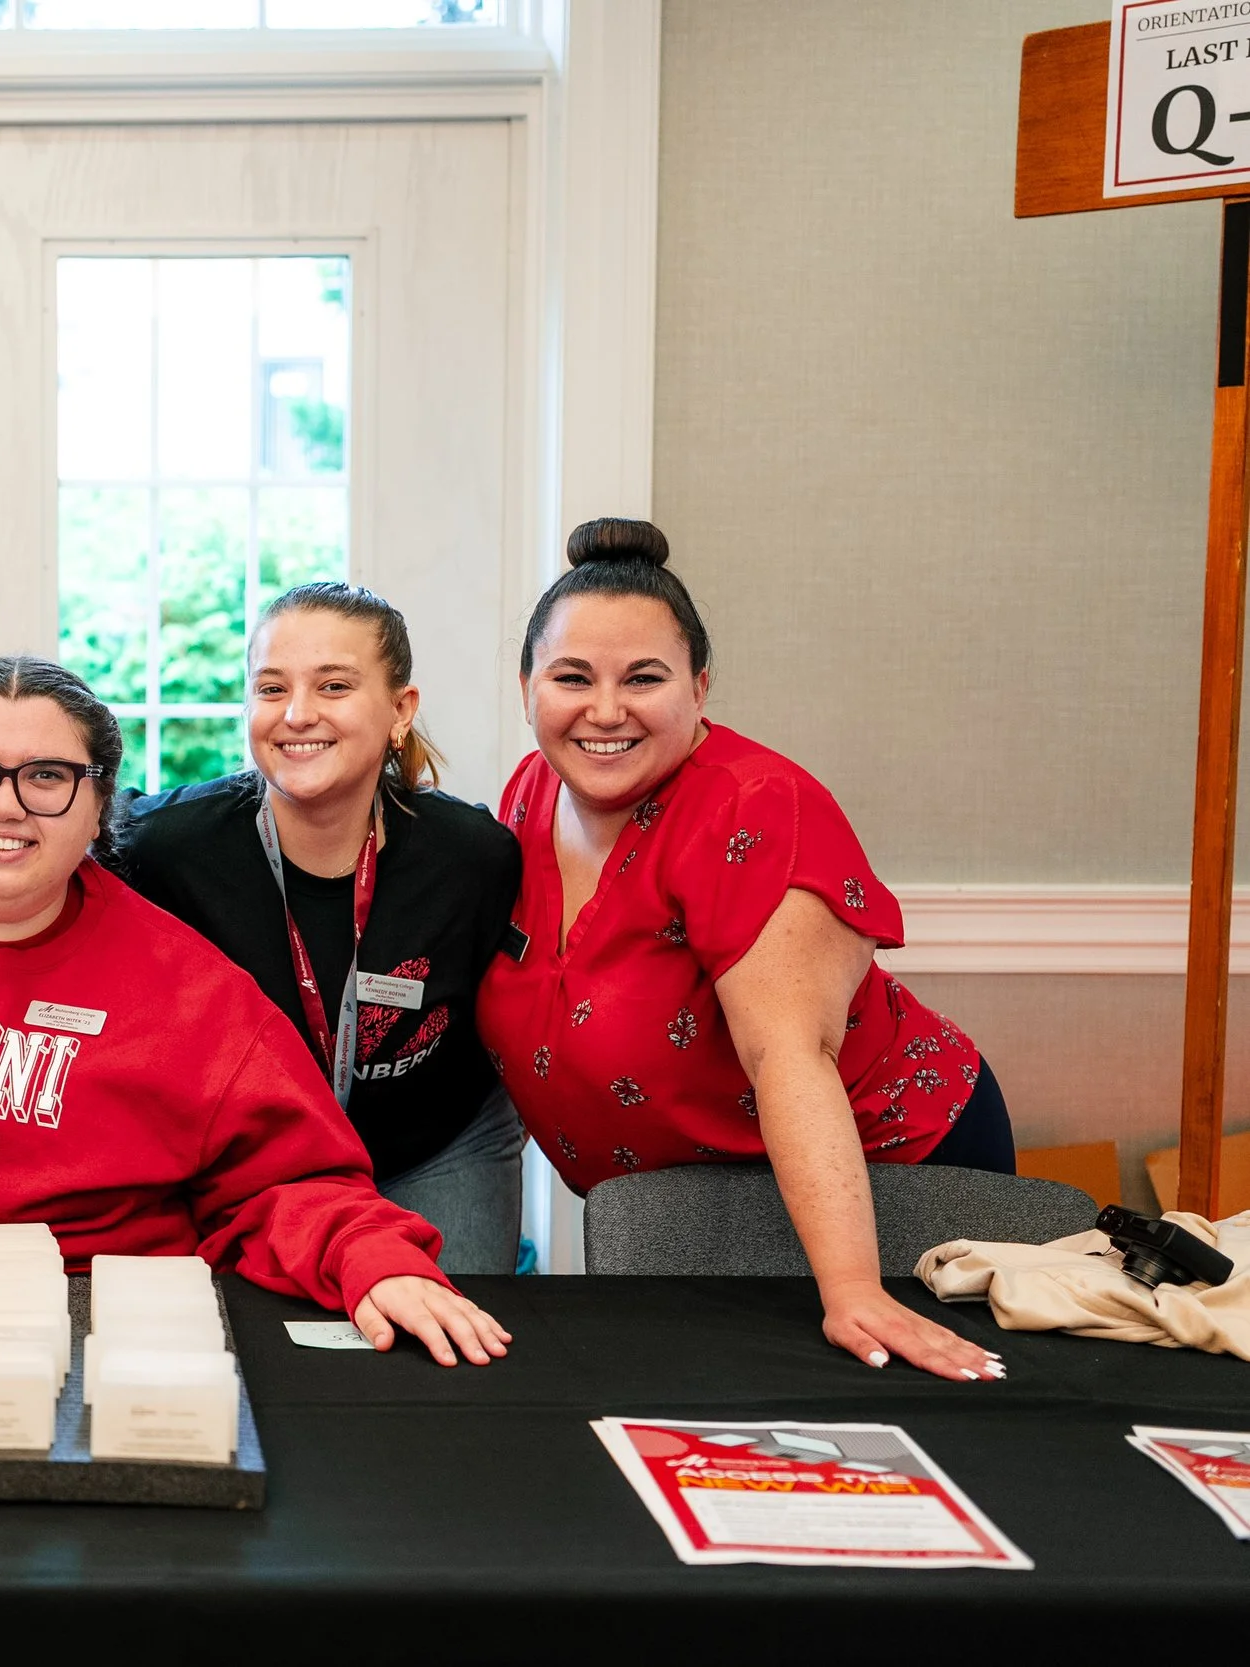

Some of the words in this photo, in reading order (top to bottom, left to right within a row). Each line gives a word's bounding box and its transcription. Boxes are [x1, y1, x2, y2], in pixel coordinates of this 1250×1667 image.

[1138, 1, 1250, 32] ORIENTATIO
[1166, 40, 1238, 70] LAST
[374, 980, 399, 989] Muhlenberg
[399, 983, 415, 991] College
[38, 1013, 66, 1021] ELIZABETH
[54, 1008, 80, 1017] Muhlenberg
[80, 1011, 96, 1019] College
[339, 1023, 351, 1065] Muhlenberg
[338, 1065, 347, 1092] College
[675, 1467, 825, 1483] ACCESS
[832, 1472, 911, 1485] THE
[677, 1475, 796, 1493] NEW
